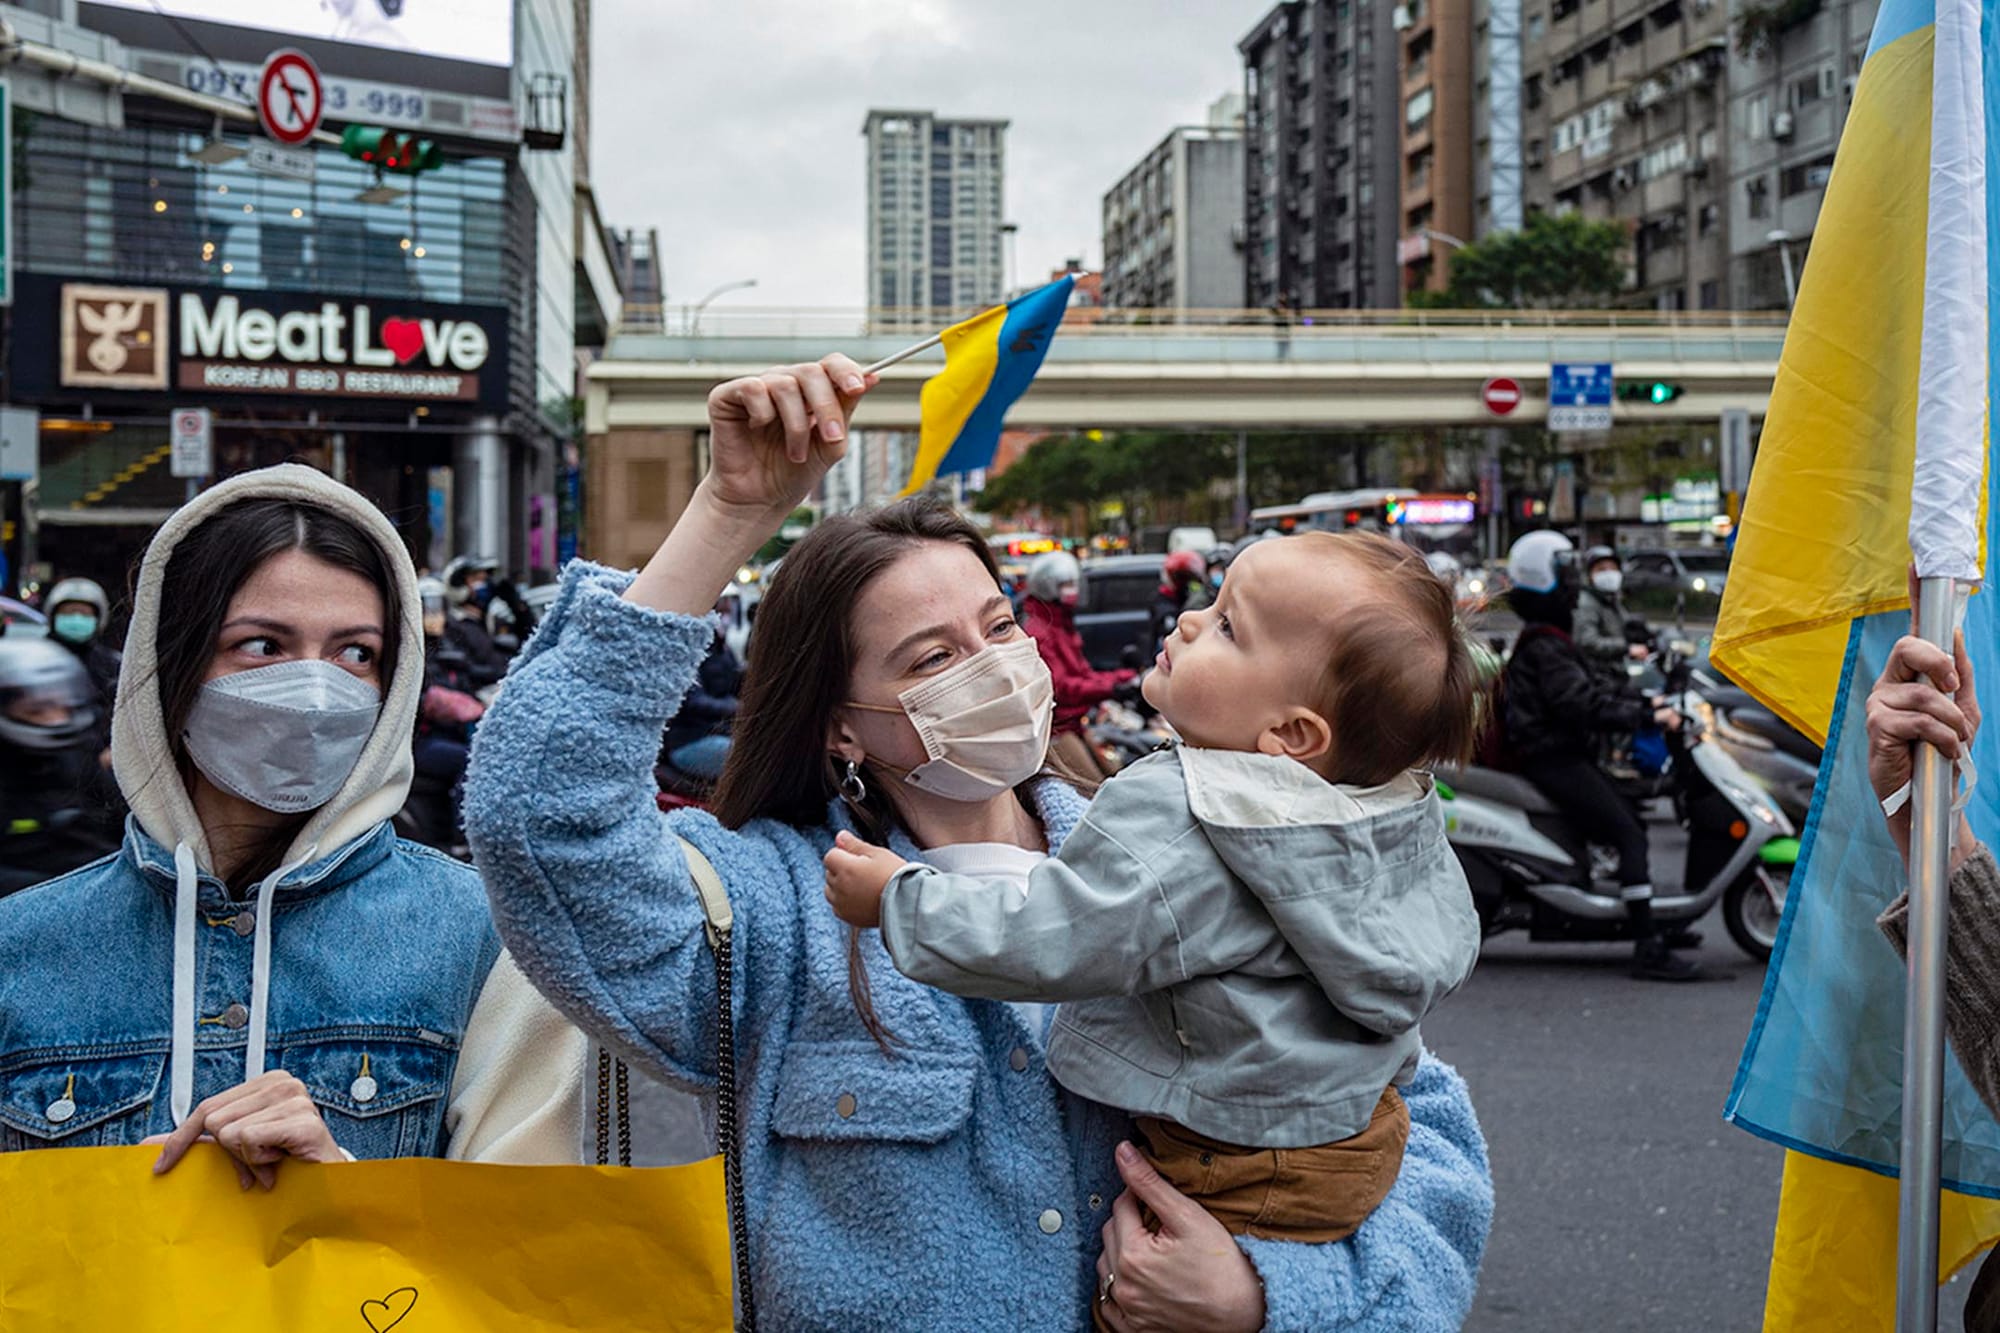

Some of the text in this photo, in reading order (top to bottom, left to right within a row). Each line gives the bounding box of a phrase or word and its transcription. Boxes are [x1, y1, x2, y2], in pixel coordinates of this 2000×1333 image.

[180, 293, 347, 361] Meat
[204, 366, 462, 396] KOREAN BBQ RESTAURANT
